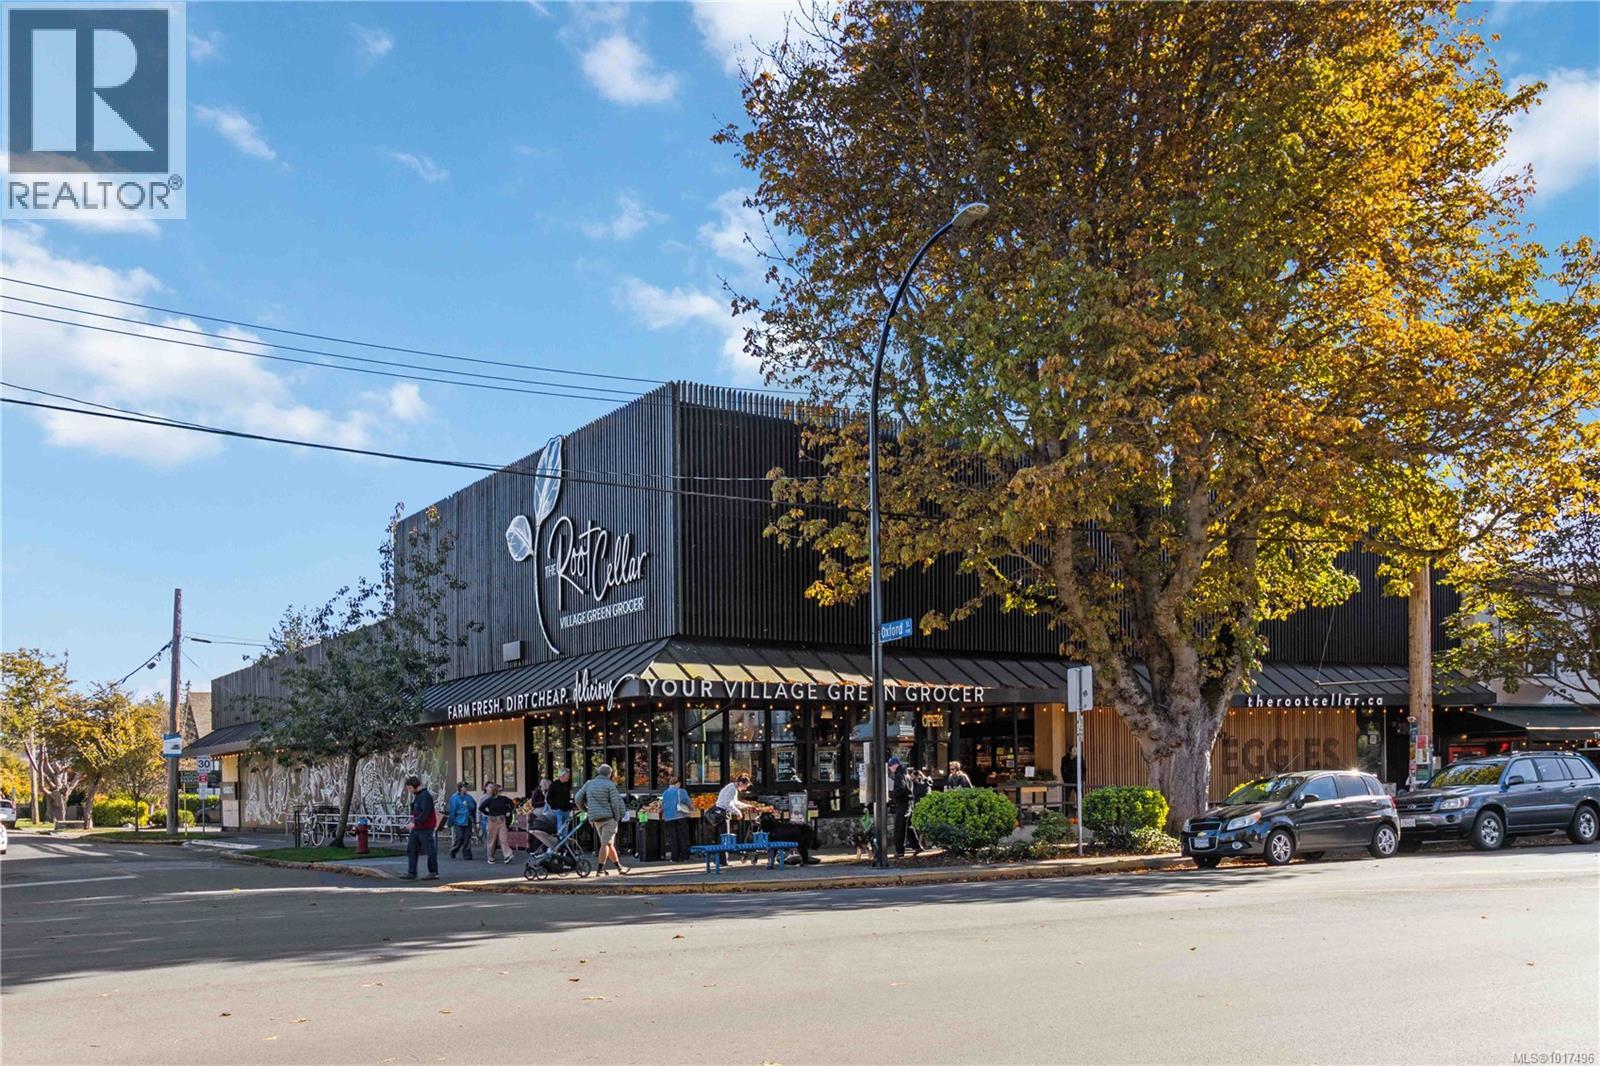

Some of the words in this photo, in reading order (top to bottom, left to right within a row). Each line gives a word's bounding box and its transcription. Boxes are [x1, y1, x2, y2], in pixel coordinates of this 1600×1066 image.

[545, 564, 557, 578] THE
[547, 515, 602, 611] Root
[592, 529, 647, 601] Cellar
[560, 611, 587, 629] VILLAGE
[586, 605, 612, 623] GREEN
[612, 596, 645, 617] GROCER
[881, 622, 903, 638] Oxford
[646, 679, 714, 697] YOUR
[724, 680, 819, 700] VILLAGE
[827, 683, 897, 702] GREN
[905, 685, 985, 703] GROCER
[1247, 692, 1384, 708] therootcellar.ca
[447, 702, 471, 720] FARM
[471, 697, 504, 716] FRESH.
[506, 692, 530, 712] DIRT
[530, 688, 569, 708] CHEAP.
[921, 713, 944, 728] OPEN
[198, 760, 210, 768] 30
